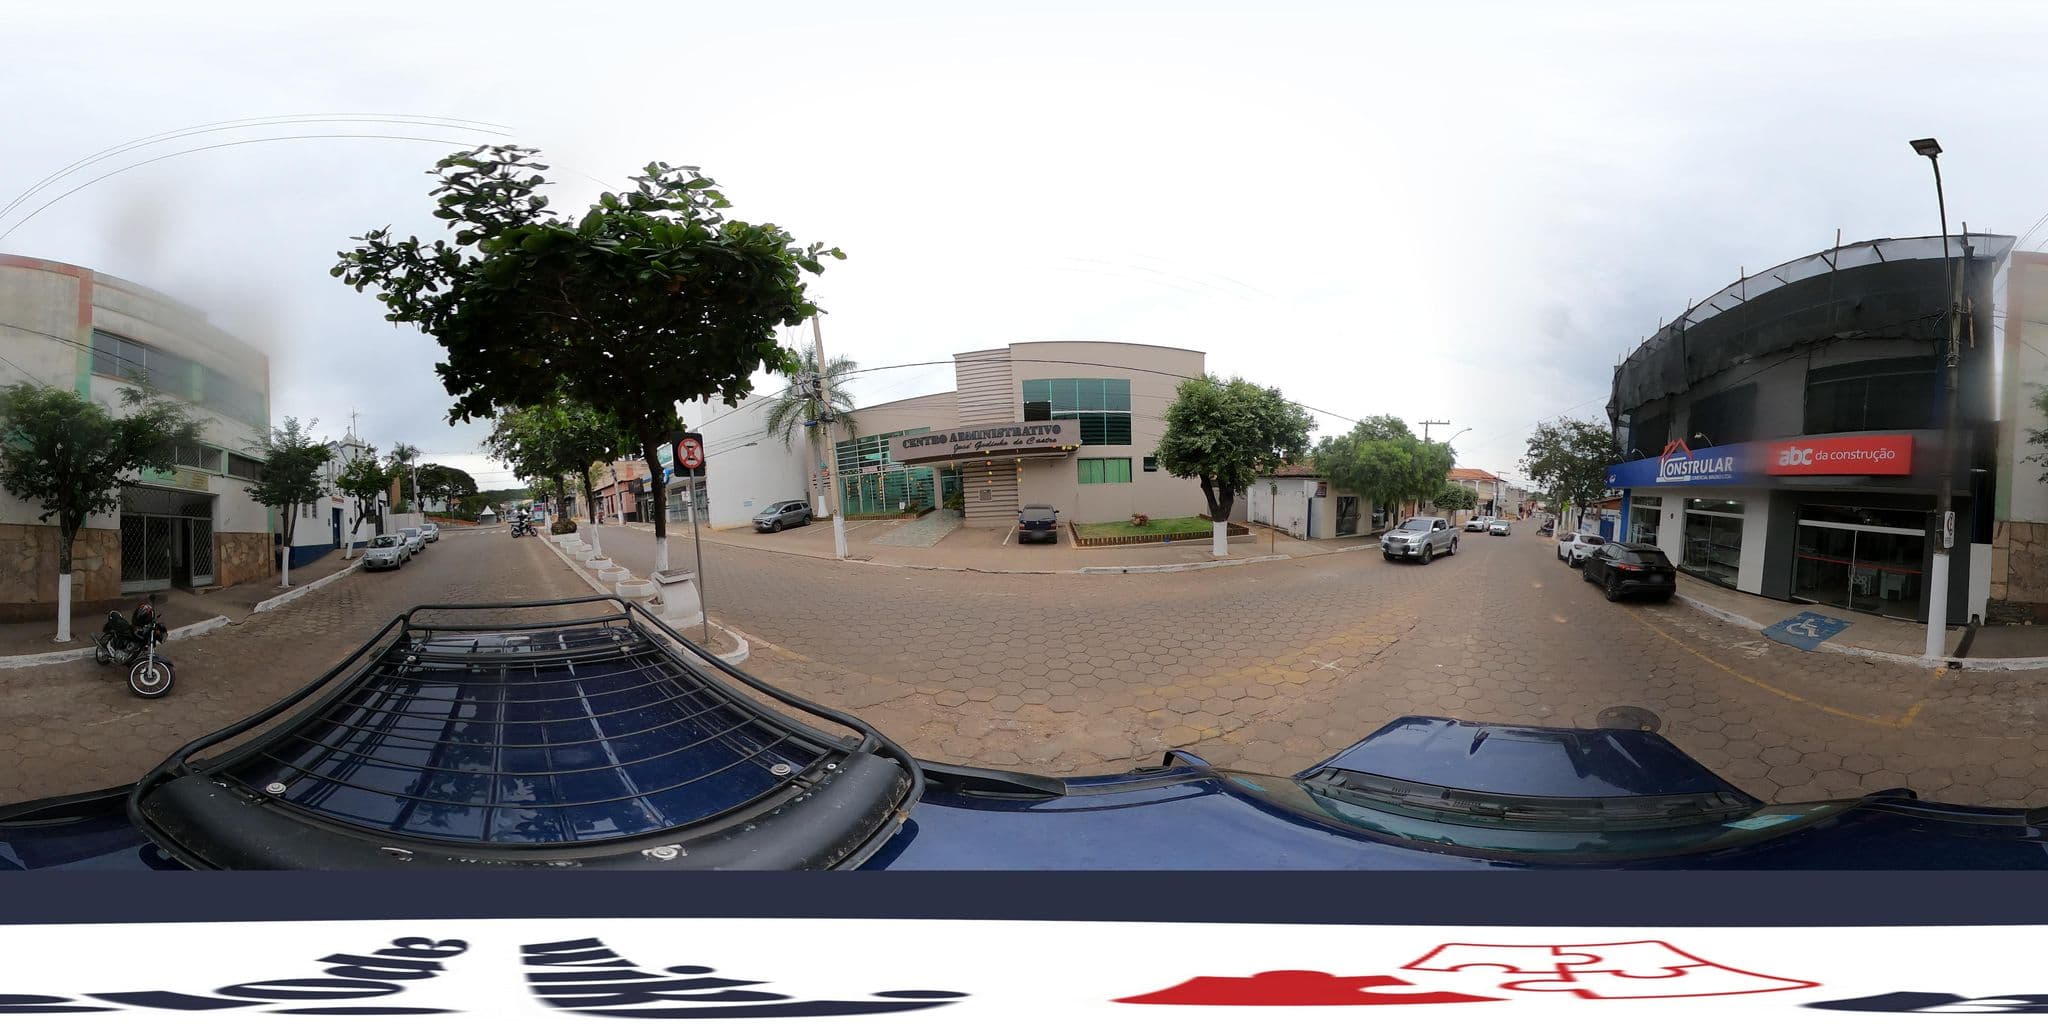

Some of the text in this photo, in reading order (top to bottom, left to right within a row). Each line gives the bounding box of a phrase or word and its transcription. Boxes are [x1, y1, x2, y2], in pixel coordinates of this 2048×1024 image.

[902, 424, 1062, 449] CENTRO ADMINISTRATIVO
[1778, 445, 1896, 466] abc da construção
